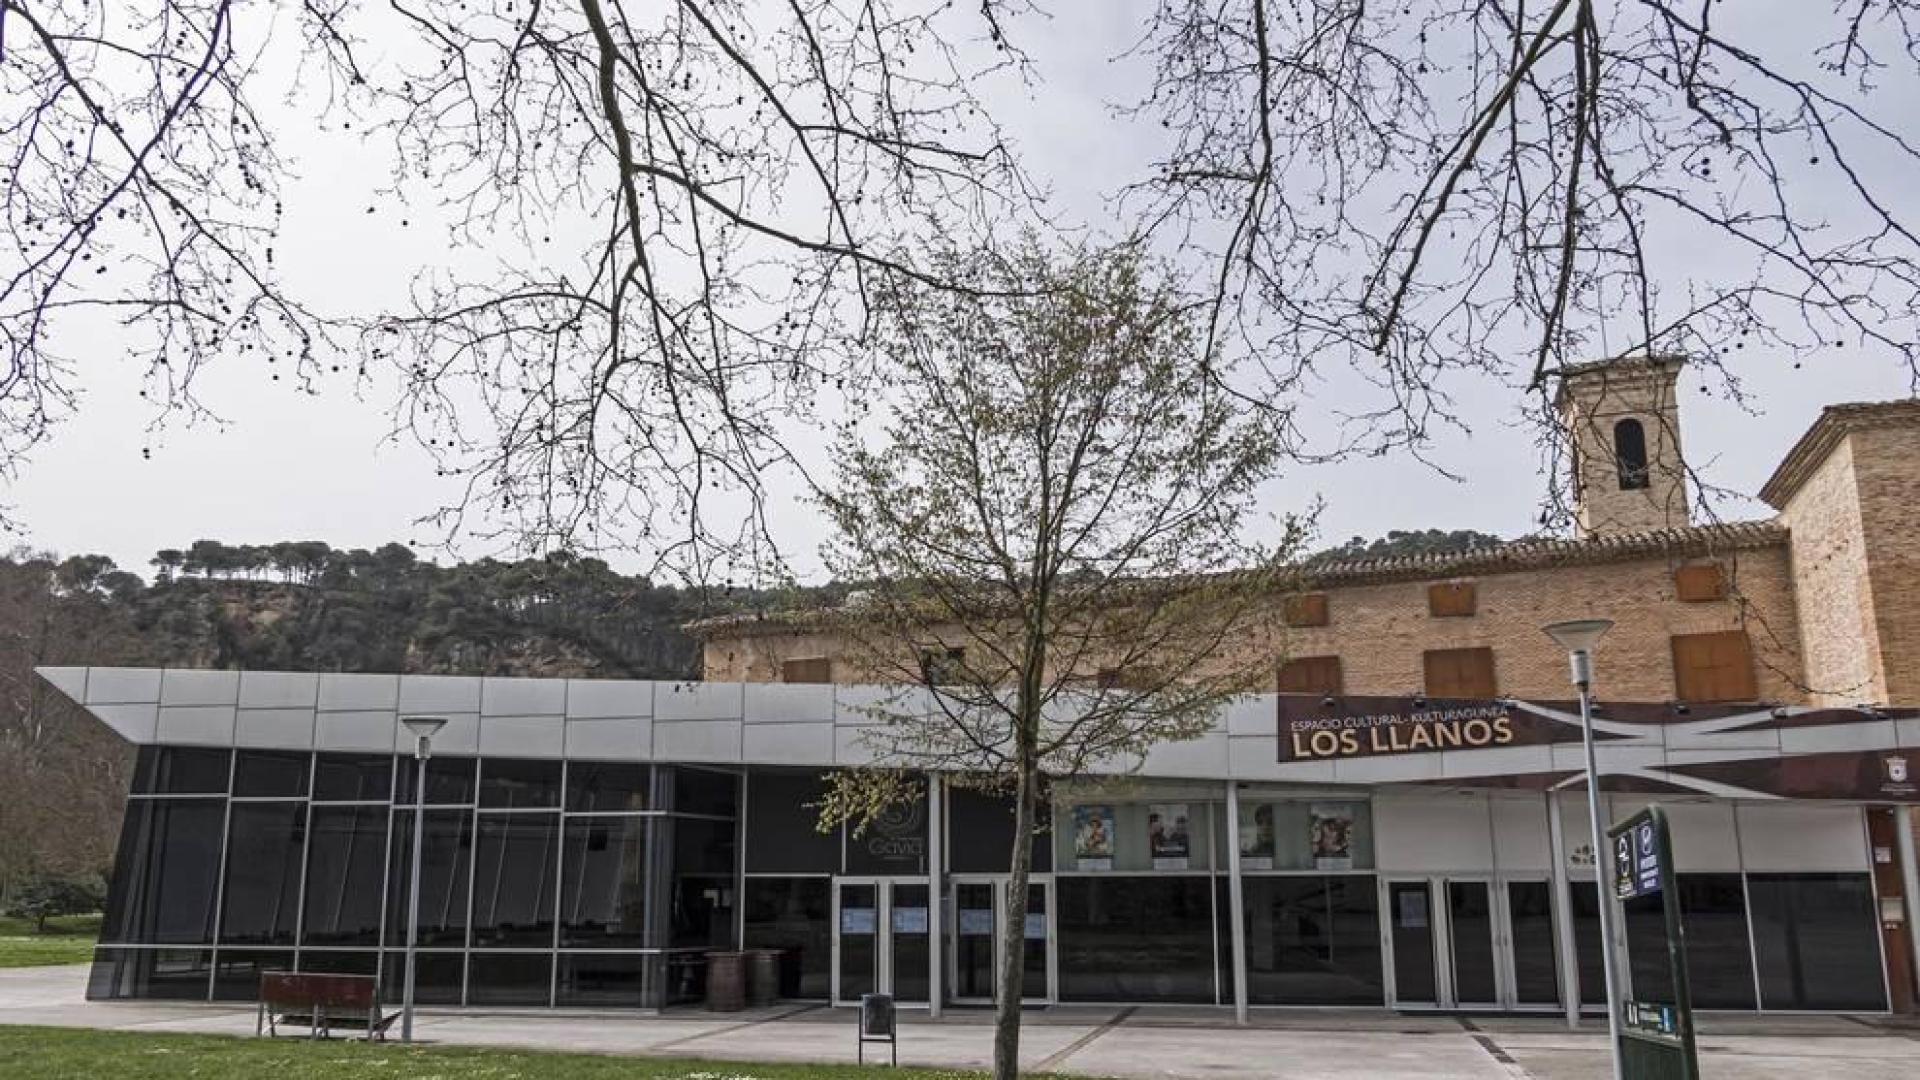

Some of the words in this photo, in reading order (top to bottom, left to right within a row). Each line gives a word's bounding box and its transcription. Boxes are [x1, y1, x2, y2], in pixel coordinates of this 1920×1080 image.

[1291, 718, 1341, 731] ESPACIO
[1292, 728, 1359, 757] LOS
[1370, 717, 1514, 752] LLANOS
